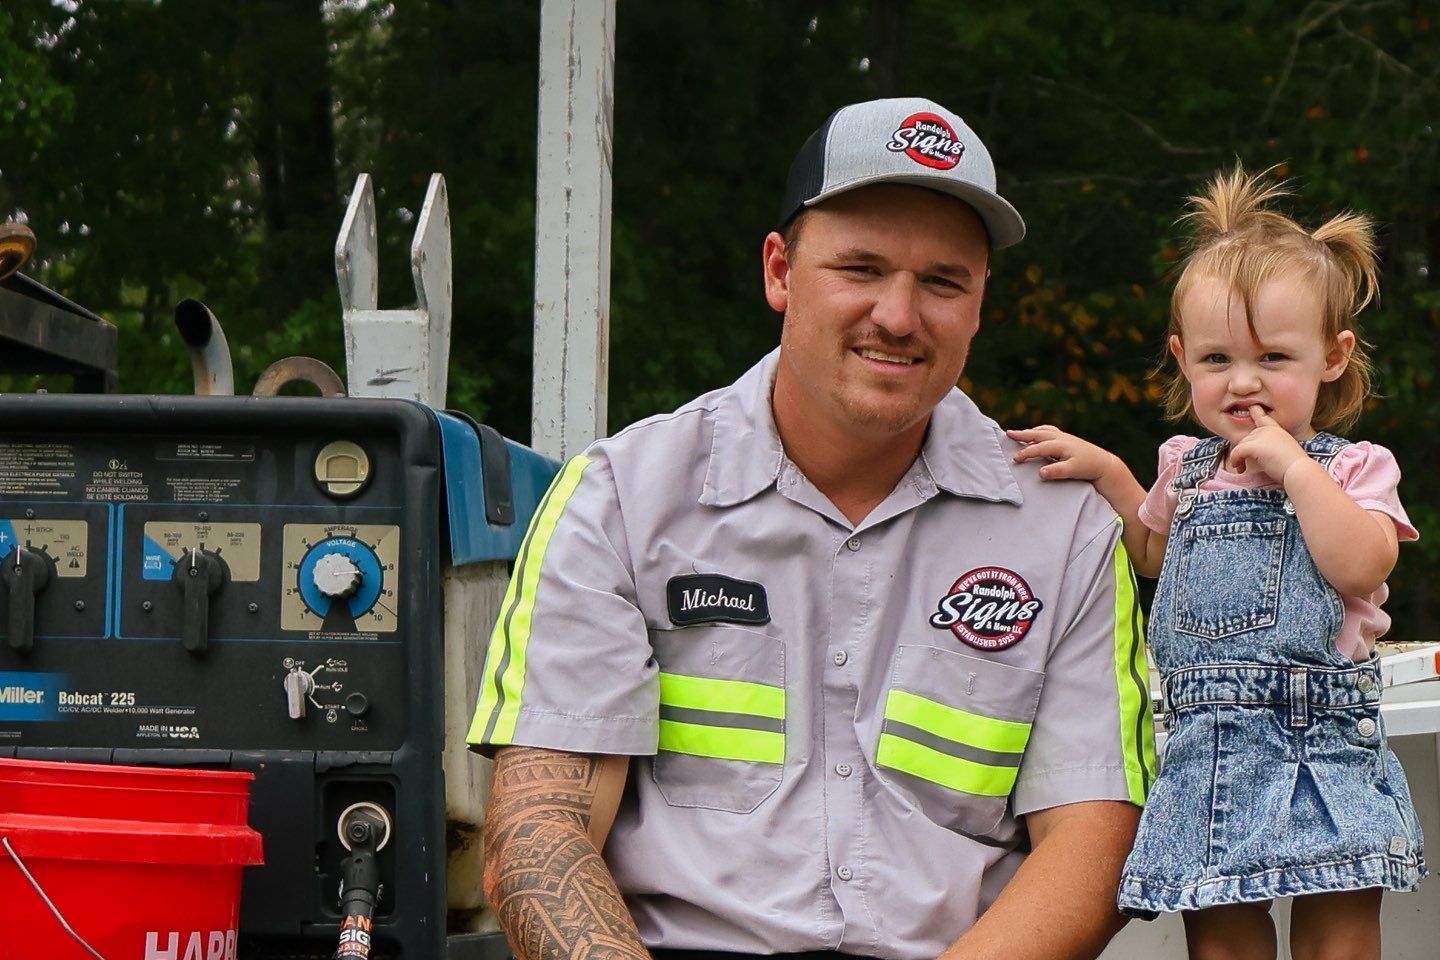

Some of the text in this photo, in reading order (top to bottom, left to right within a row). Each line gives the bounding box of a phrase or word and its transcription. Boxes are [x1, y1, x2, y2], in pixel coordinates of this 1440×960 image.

[916, 121, 951, 138] Randolph
[888, 128, 963, 154] Signs
[113, 493, 149, 501] SOLDANDO
[121, 486, 149, 494] CUANDO
[324, 525, 358, 533] AMPERAGE
[327, 539, 356, 548] VOLTAGE
[973, 584, 1015, 600] Randolph
[977, 571, 990, 580] GOT
[991, 570, 999, 579] IT
[999, 572, 1018, 586] FROM
[1015, 582, 1029, 601] HERE
[680, 588, 756, 612] Michael
[933, 592, 1039, 630] Signs
[957, 624, 997, 647] ESTABLISHED
[993, 622, 1011, 632] More
[1011, 626, 1023, 634] LLC
[0, 686, 44, 704] Miller
[111, 692, 136, 706] 225
[80, 706, 102, 714] AC/DC
[139, 724, 159, 732] MADE
[169, 726, 200, 739] USA
[339, 929, 371, 949] SIG
